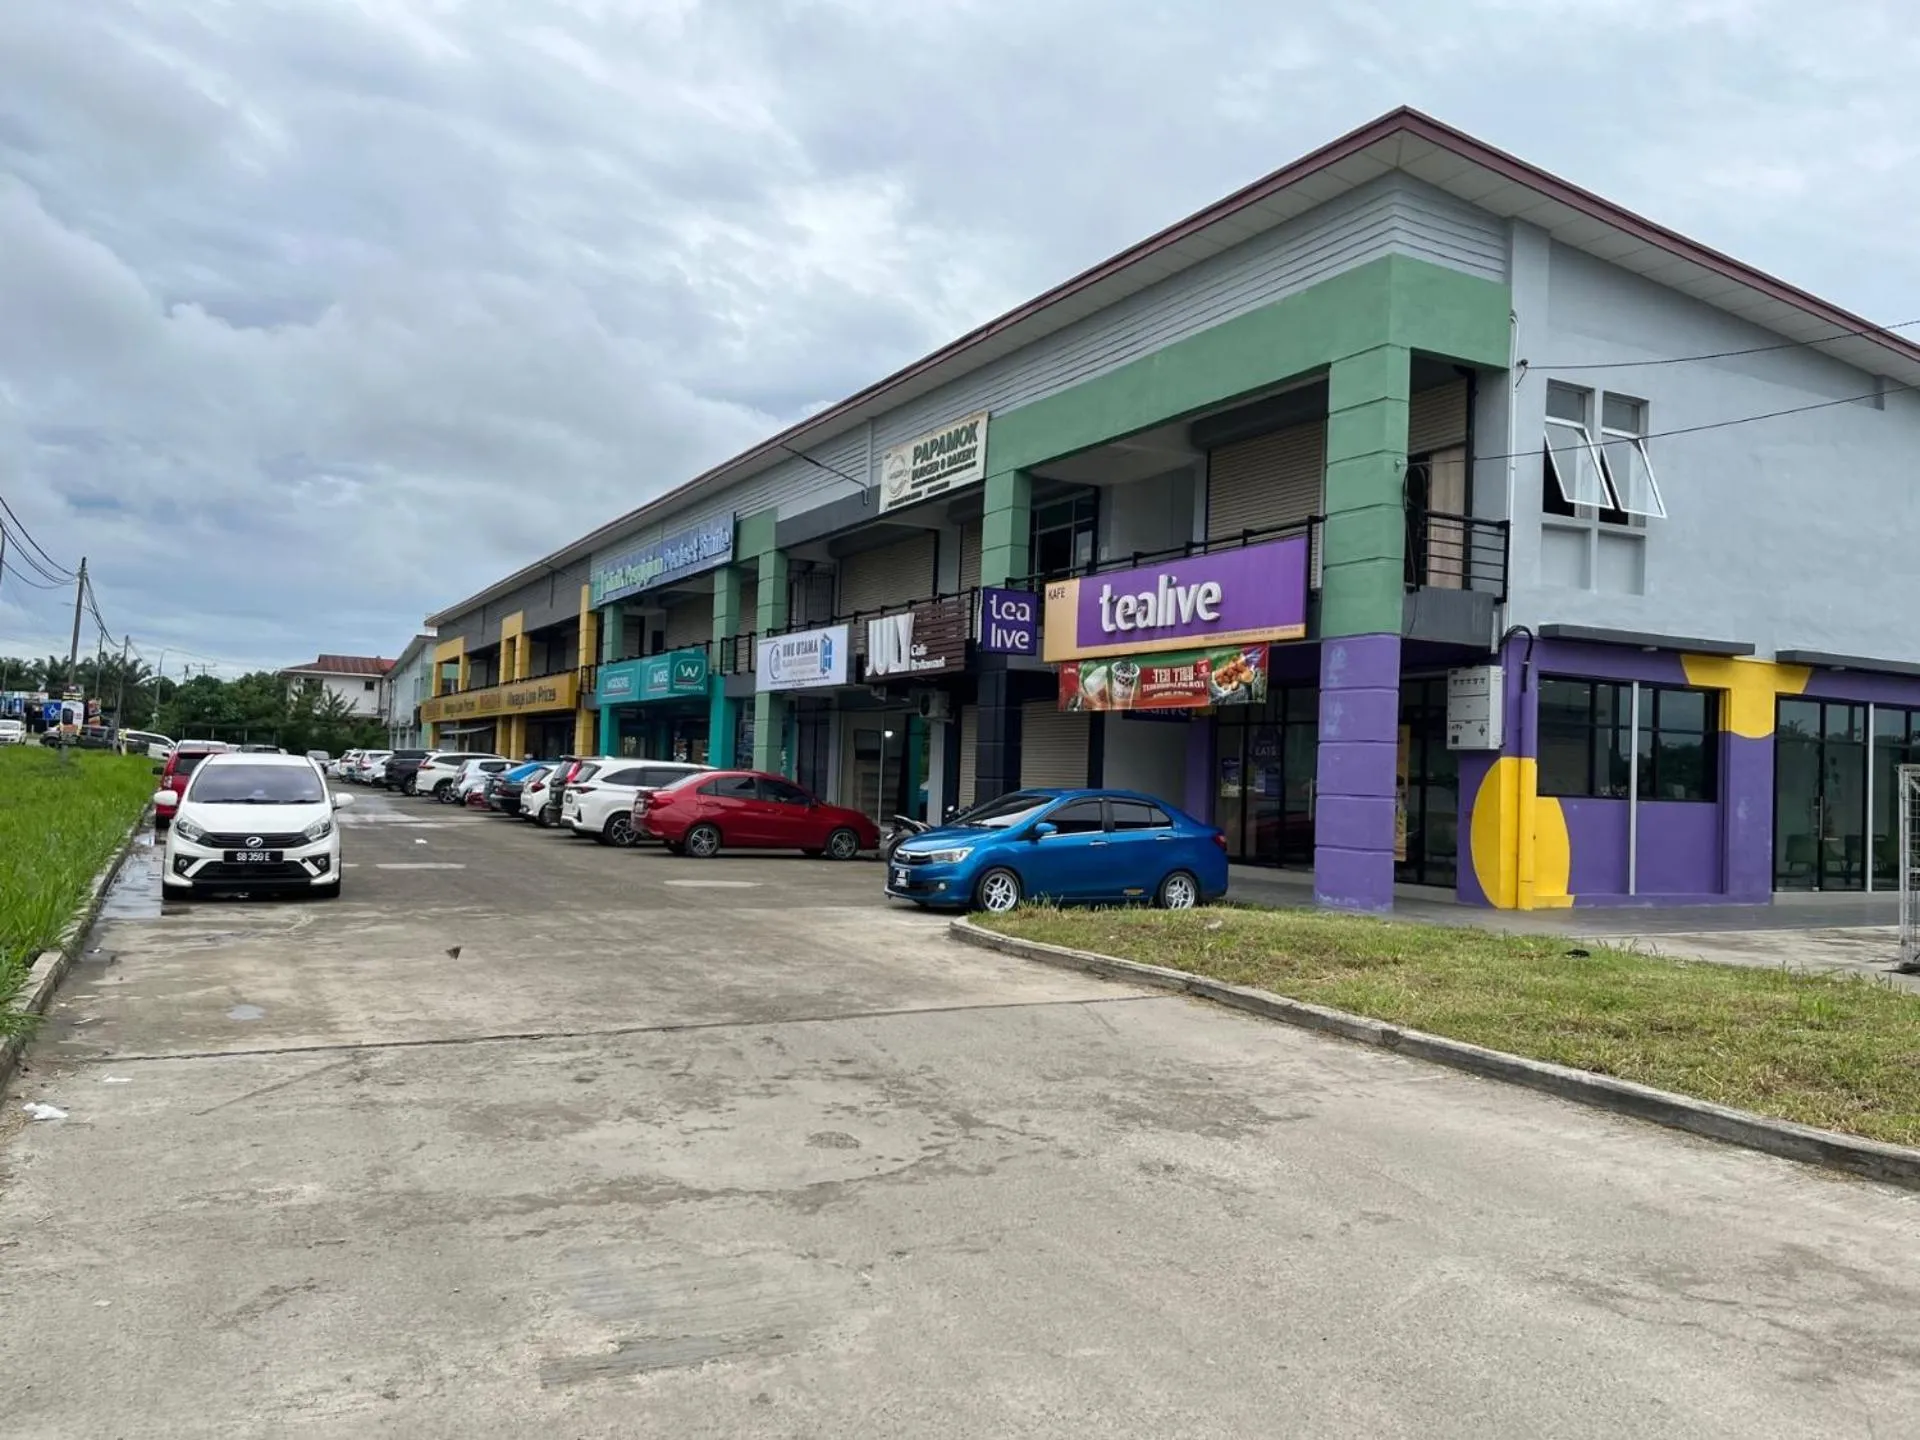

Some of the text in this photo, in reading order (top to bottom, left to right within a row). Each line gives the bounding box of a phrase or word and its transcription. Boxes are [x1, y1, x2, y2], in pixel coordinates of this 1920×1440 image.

[912, 420, 980, 466] PAPAMOK
[911, 460, 940, 481] BURGER
[946, 445, 978, 468] BAKERY
[989, 594, 1030, 622] tea
[1047, 587, 1066, 600] KAFE
[1099, 574, 1222, 633] tealive
[865, 612, 915, 677] JULY
[990, 623, 1030, 649] live
